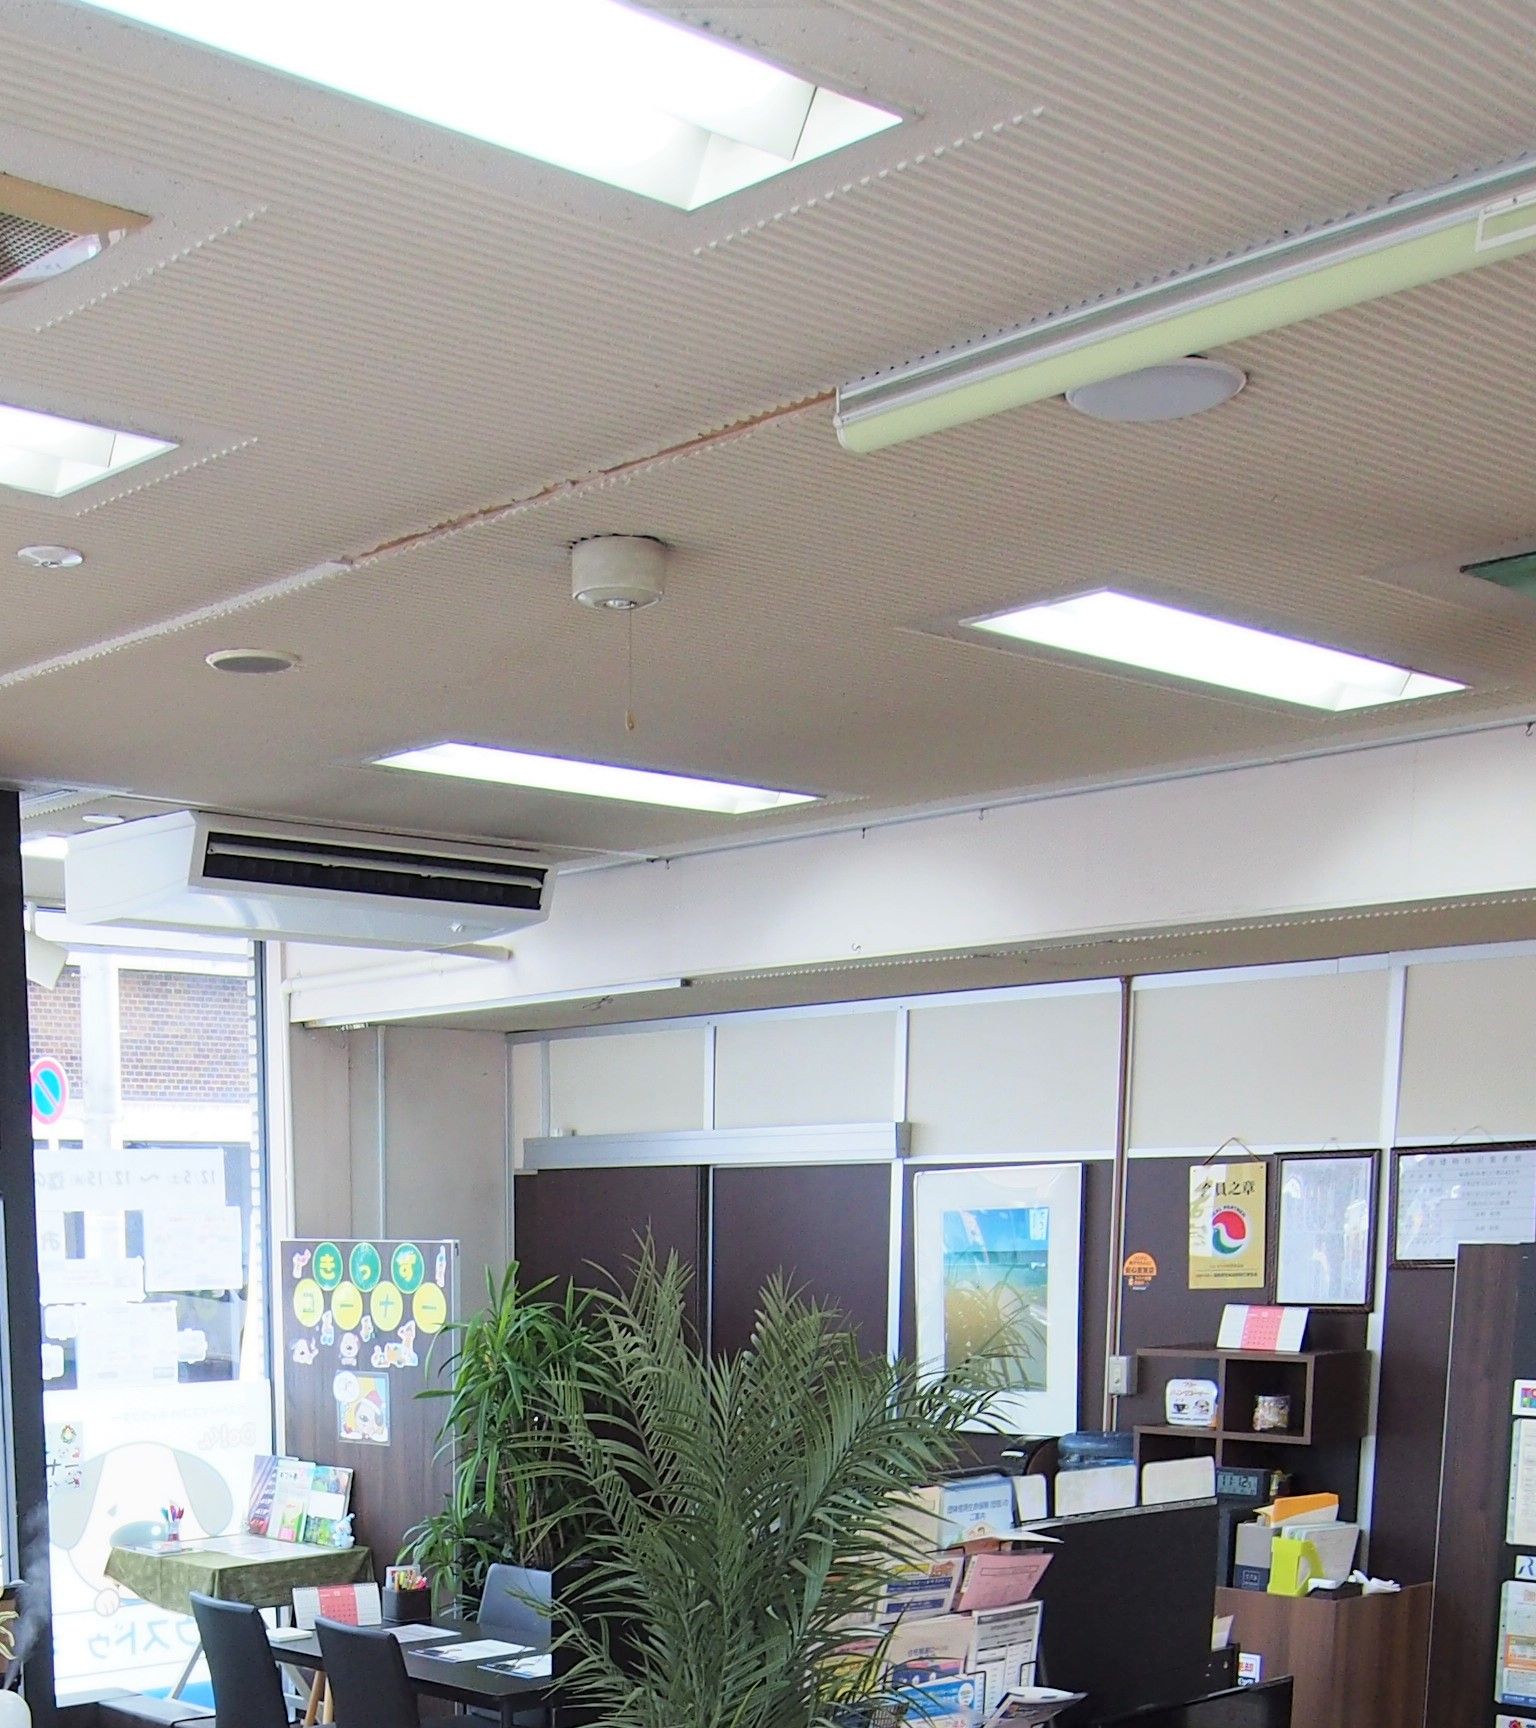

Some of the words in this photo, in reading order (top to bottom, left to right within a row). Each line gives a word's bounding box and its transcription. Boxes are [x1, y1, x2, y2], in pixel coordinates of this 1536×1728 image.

[319, 1251, 419, 1281] きっず
[302, 1291, 439, 1319] コーナー
